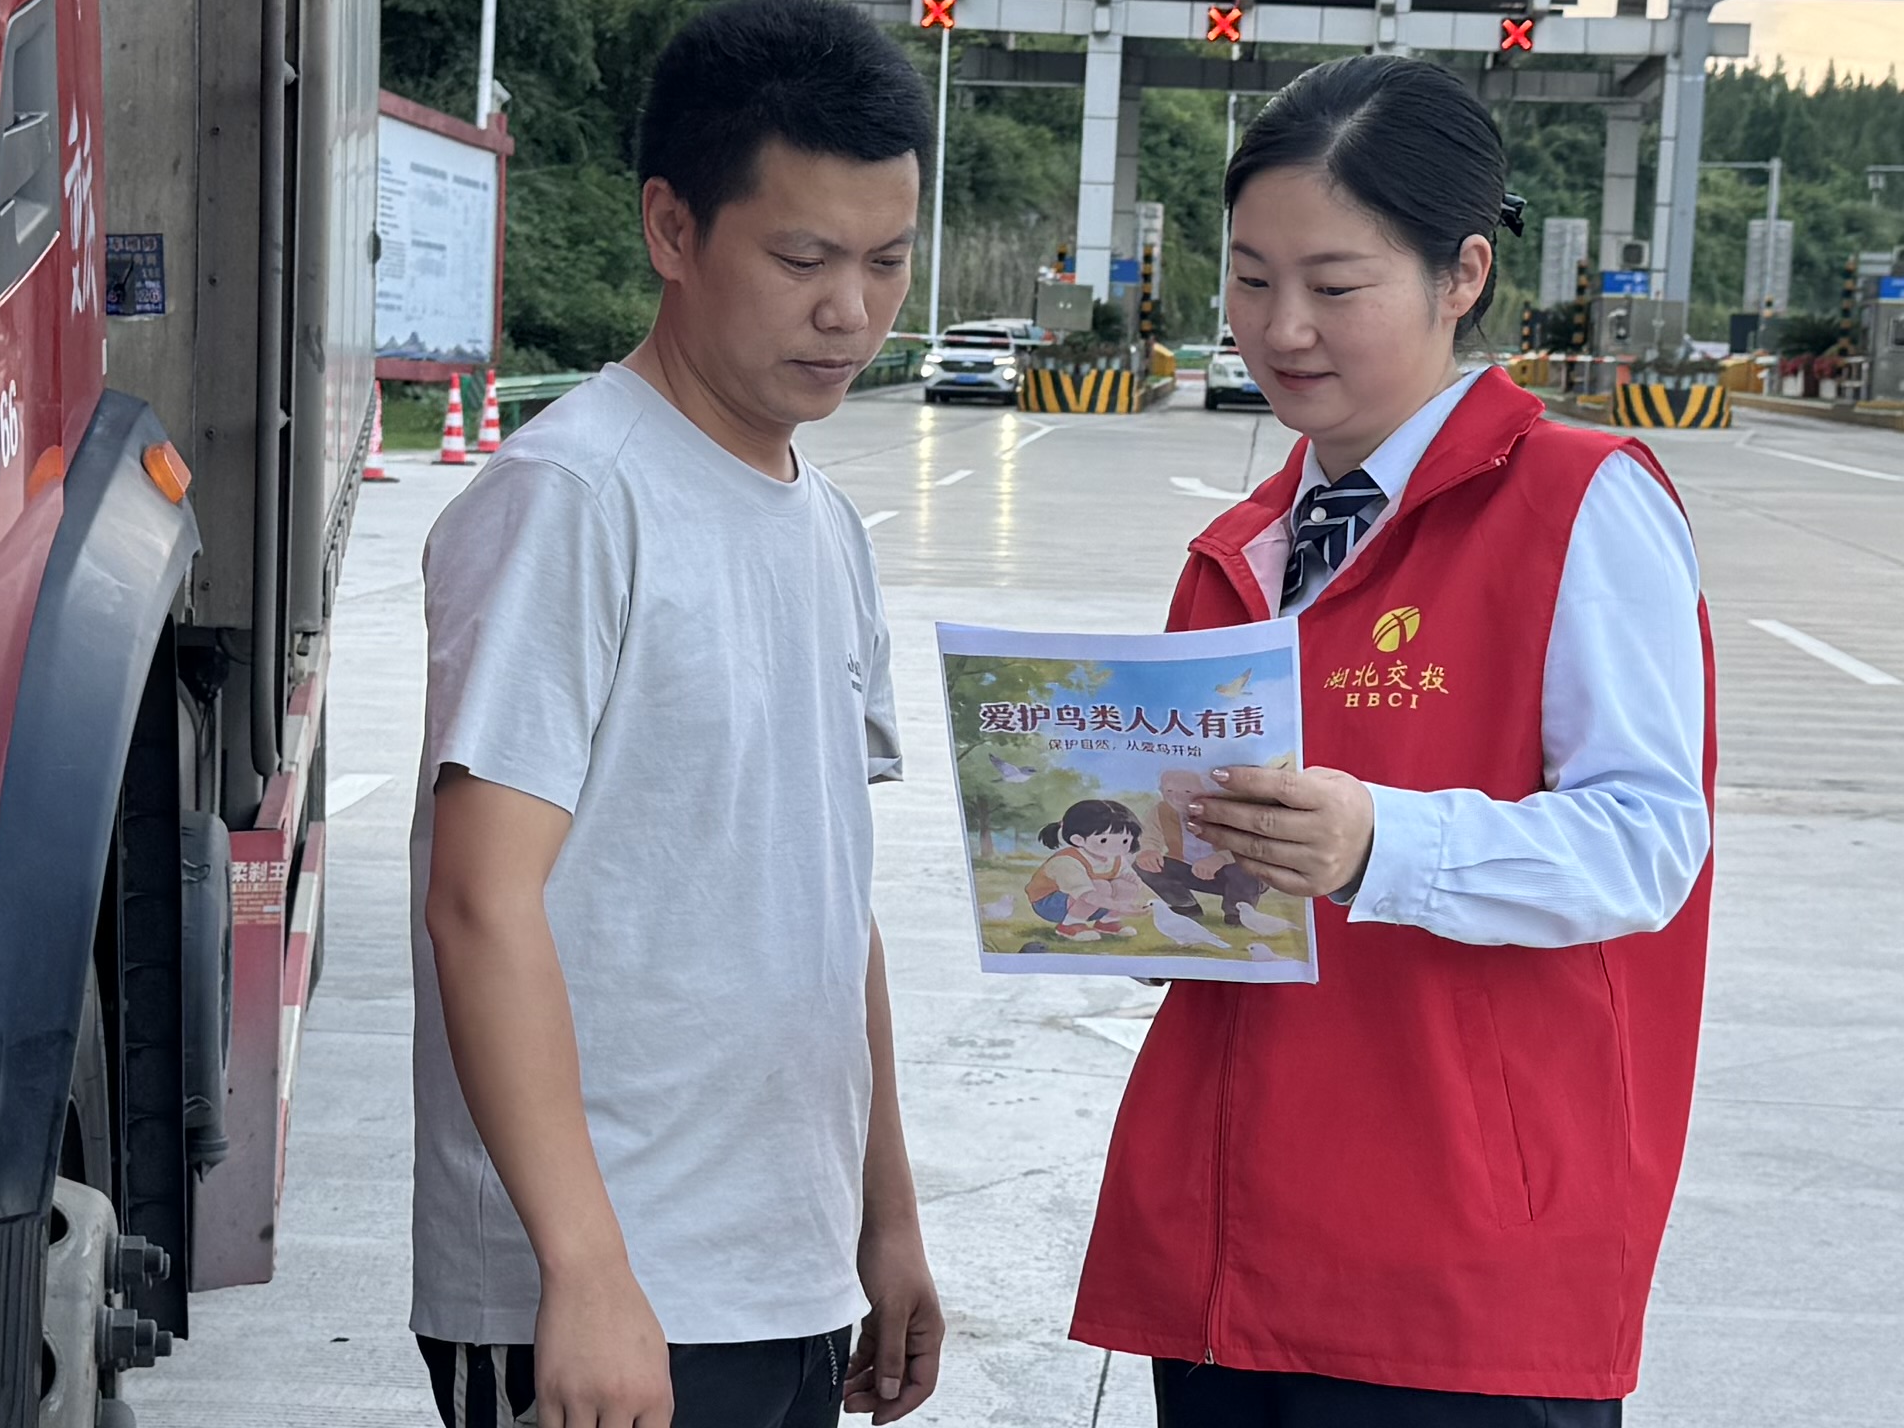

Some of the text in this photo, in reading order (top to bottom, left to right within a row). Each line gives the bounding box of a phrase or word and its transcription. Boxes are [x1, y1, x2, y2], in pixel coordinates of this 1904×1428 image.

[1323, 659, 1450, 695] 湖北交投
[1344, 692, 1419, 710] HBCI
[978, 702, 1265, 740] 爱护鸟类人人有责
